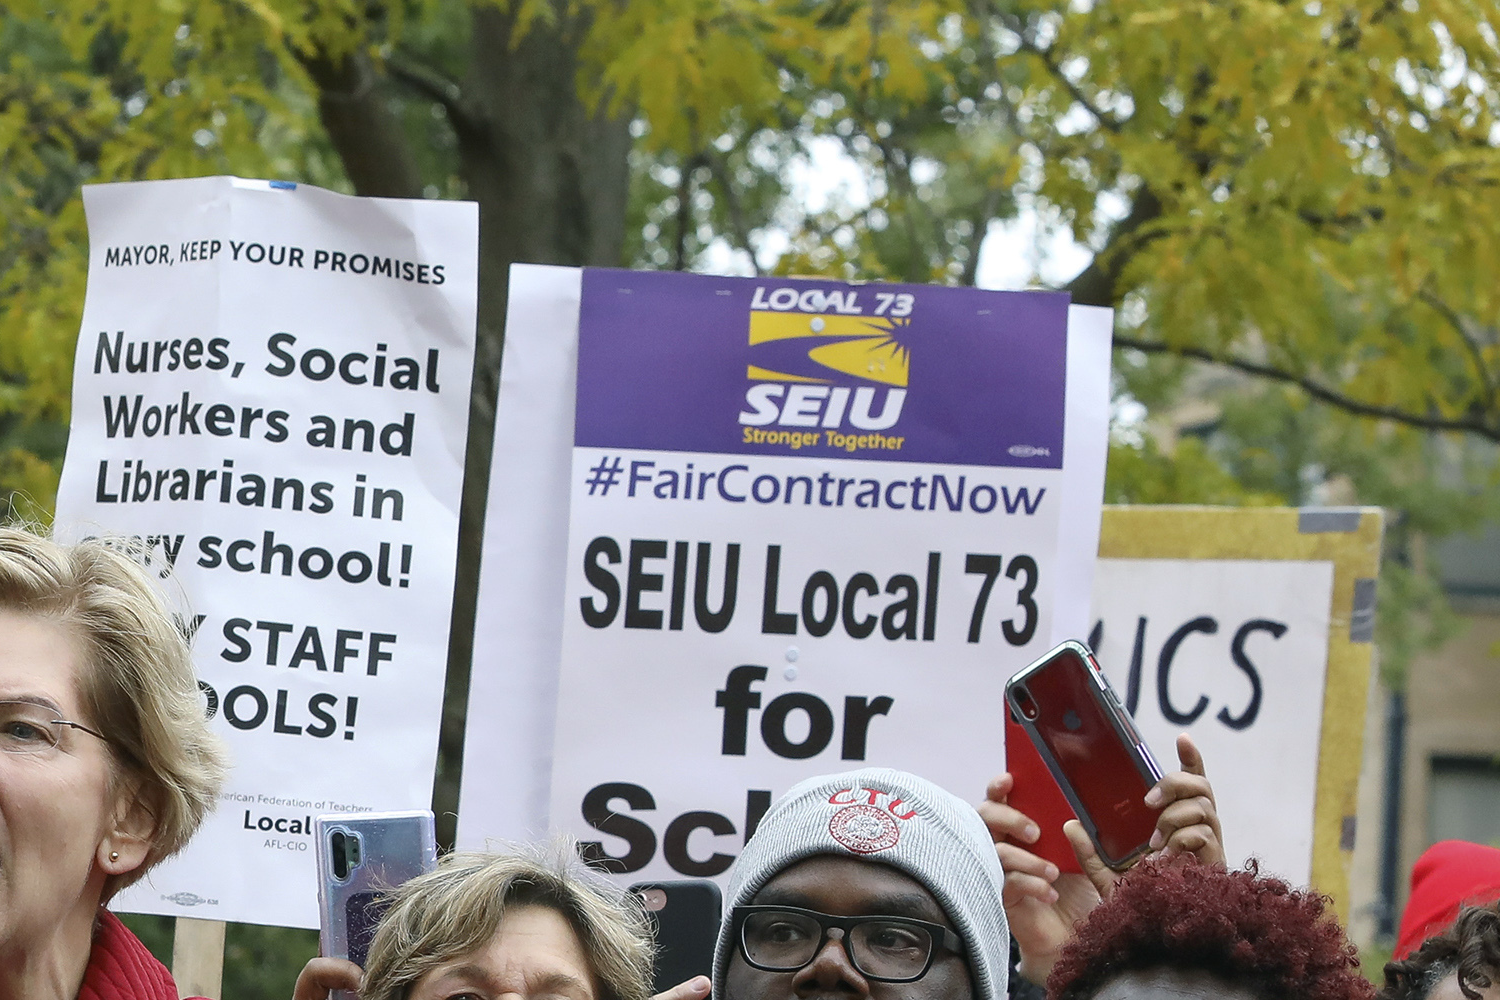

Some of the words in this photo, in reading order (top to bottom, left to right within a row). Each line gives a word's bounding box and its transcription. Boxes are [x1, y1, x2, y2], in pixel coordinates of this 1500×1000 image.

[105, 244, 175, 268] MAYOR,
[180, 240, 221, 262] KEEP
[229, 241, 304, 268] YOUR
[313, 250, 445, 285] PROMISES
[751, 286, 863, 314] LOCAL
[873, 293, 915, 317] 73
[93, 331, 245, 378] Nurses,
[265, 333, 440, 393] Social
[103, 392, 289, 443] Workers
[306, 413, 415, 456] and
[738, 383, 907, 431] SEIU
[743, 427, 821, 449] Stronger
[825, 430, 905, 452] Together
[96, 460, 334, 514] Librarians
[352, 475, 405, 521] in
[585, 455, 1047, 516] #FairContractNow
[197, 531, 413, 588] school!
[579, 534, 741, 634] SEIU
[761, 544, 941, 641] Local
[963, 553, 1039, 646] 73
[220, 617, 397, 676] STAFF
[1088, 615, 1290, 732] ICS
[715, 665, 894, 762] for
[243, 810, 311, 836] Local
[257, 794, 311, 809] Federation
[315, 797, 326, 809] of
[829, 788, 918, 820] CTU
[264, 838, 308, 851] AFL-CIO
